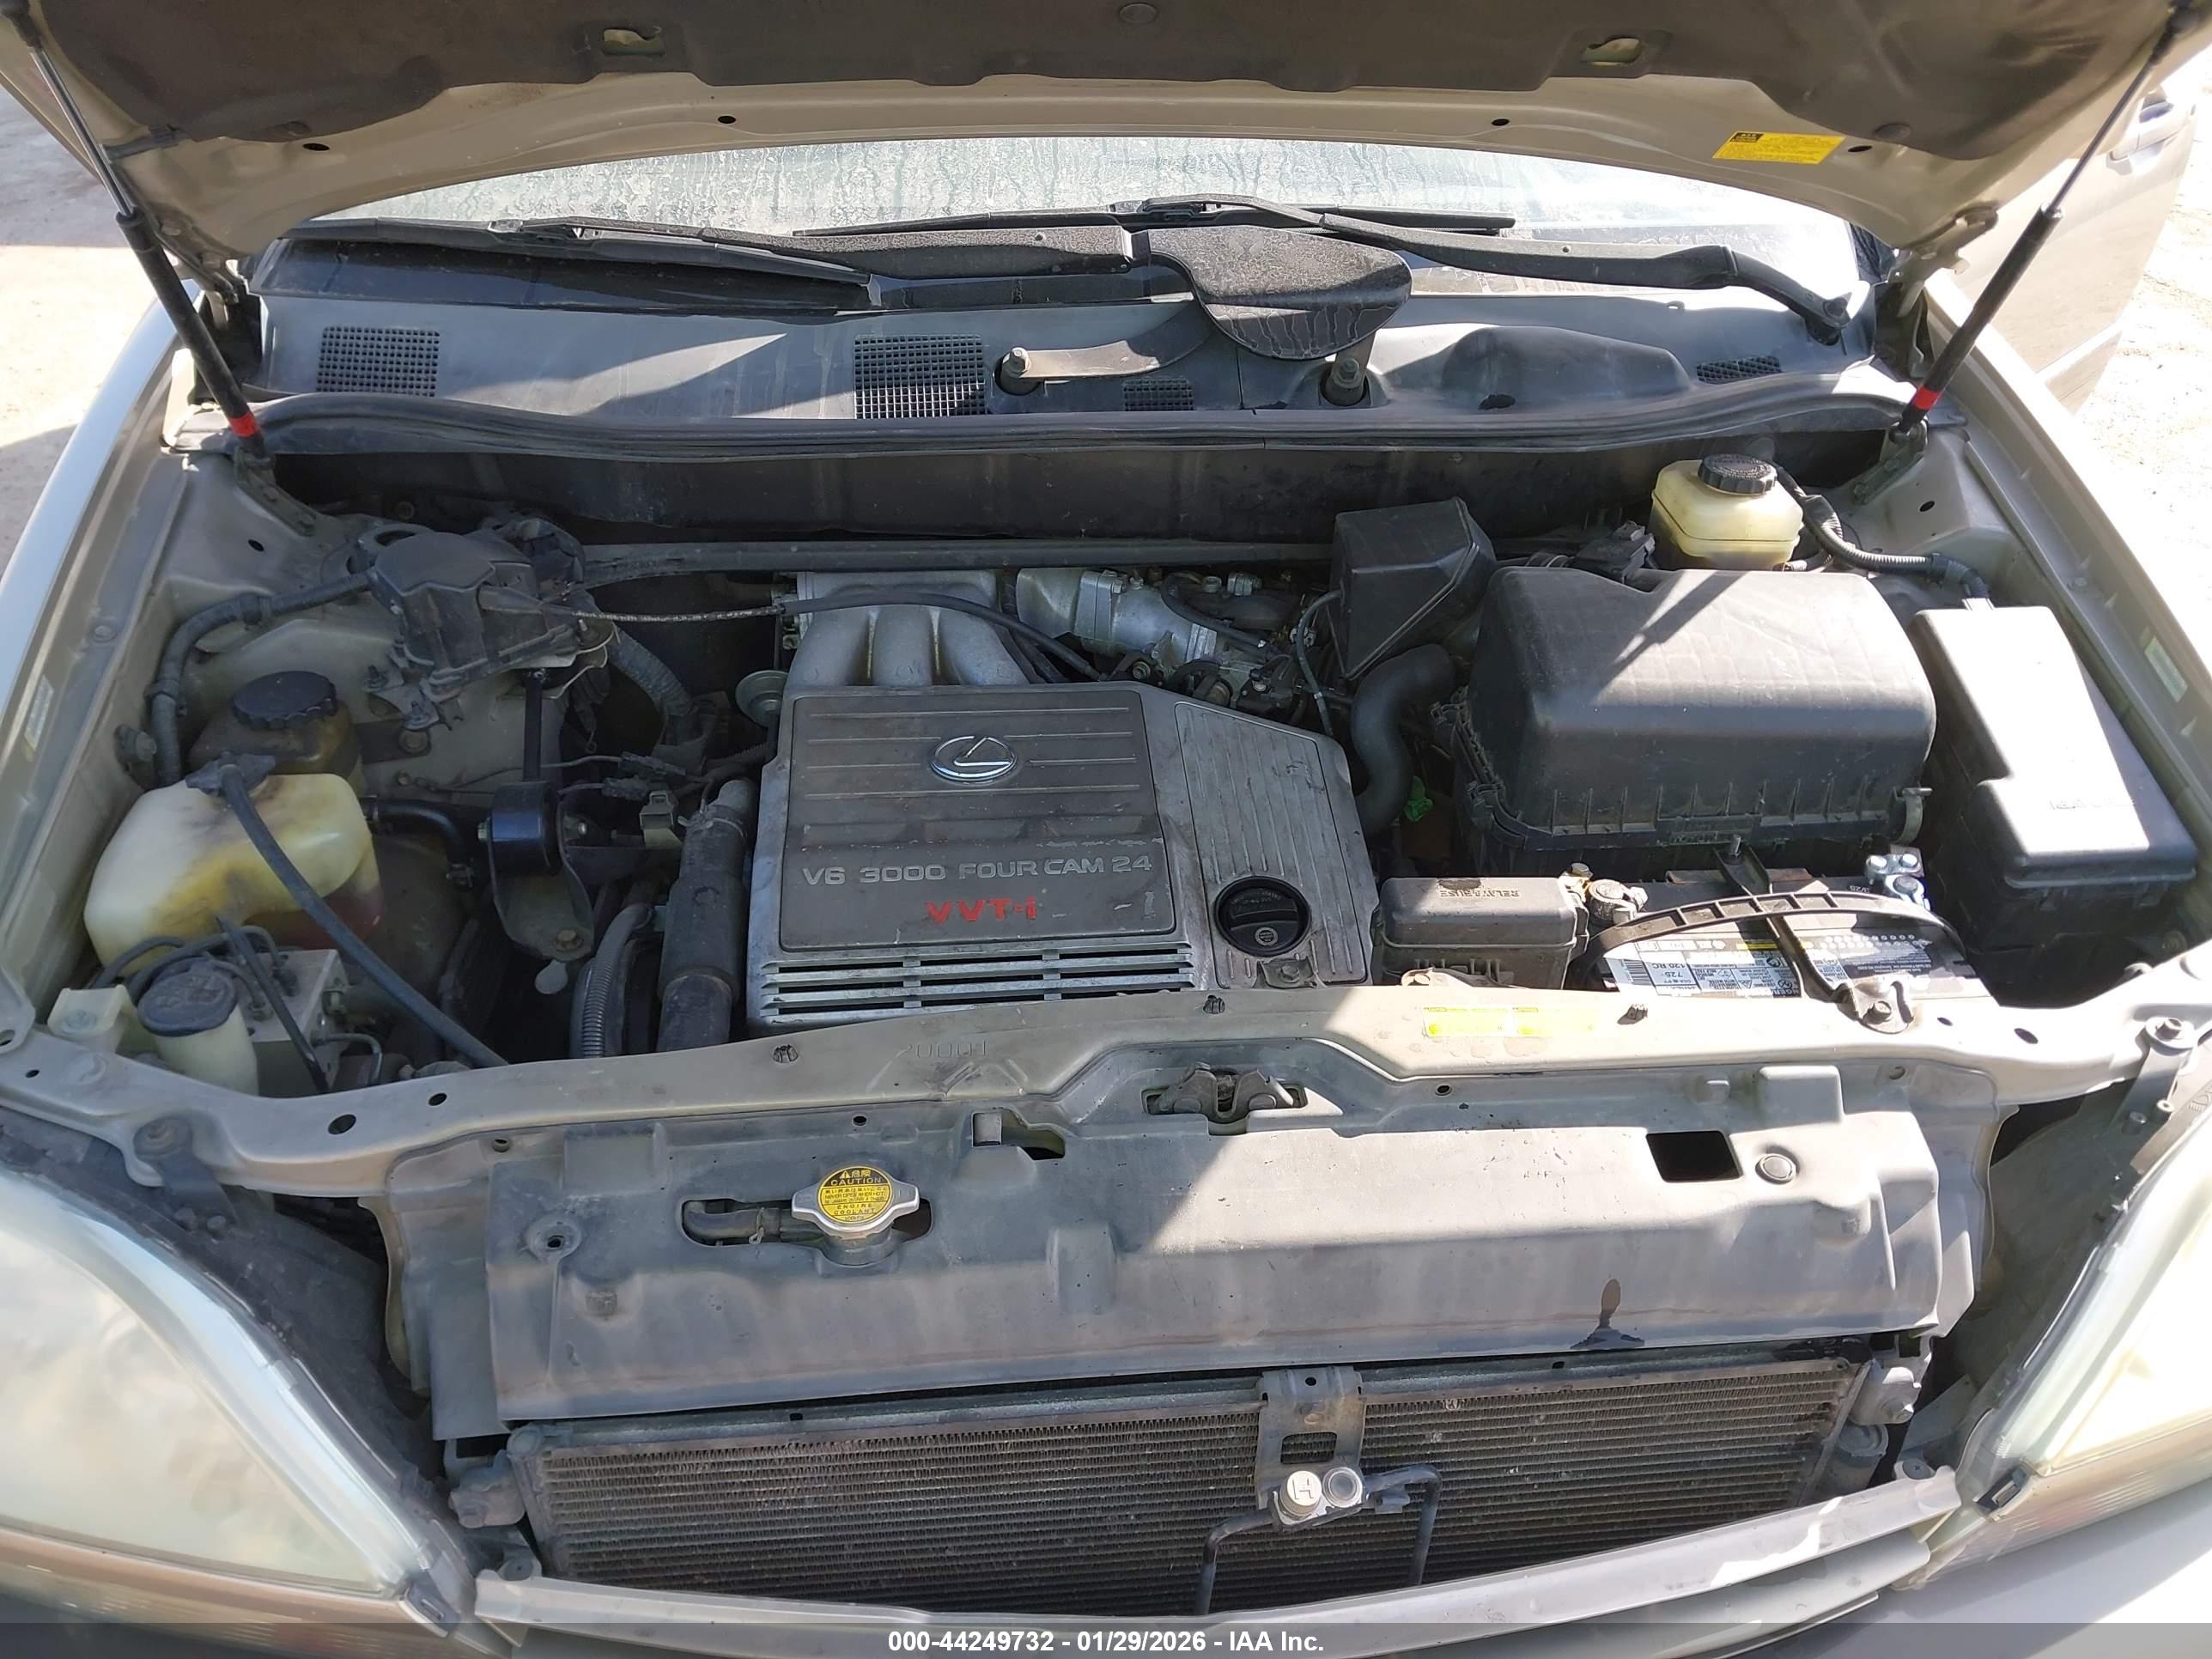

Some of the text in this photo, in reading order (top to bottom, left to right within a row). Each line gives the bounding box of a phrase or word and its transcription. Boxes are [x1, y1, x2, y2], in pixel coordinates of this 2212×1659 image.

[803, 855, 1152, 885] V6 3000 FOUR CAM 24
[924, 897, 1037, 924] VVT-i
[830, 1177, 882, 1187] CAUTION
